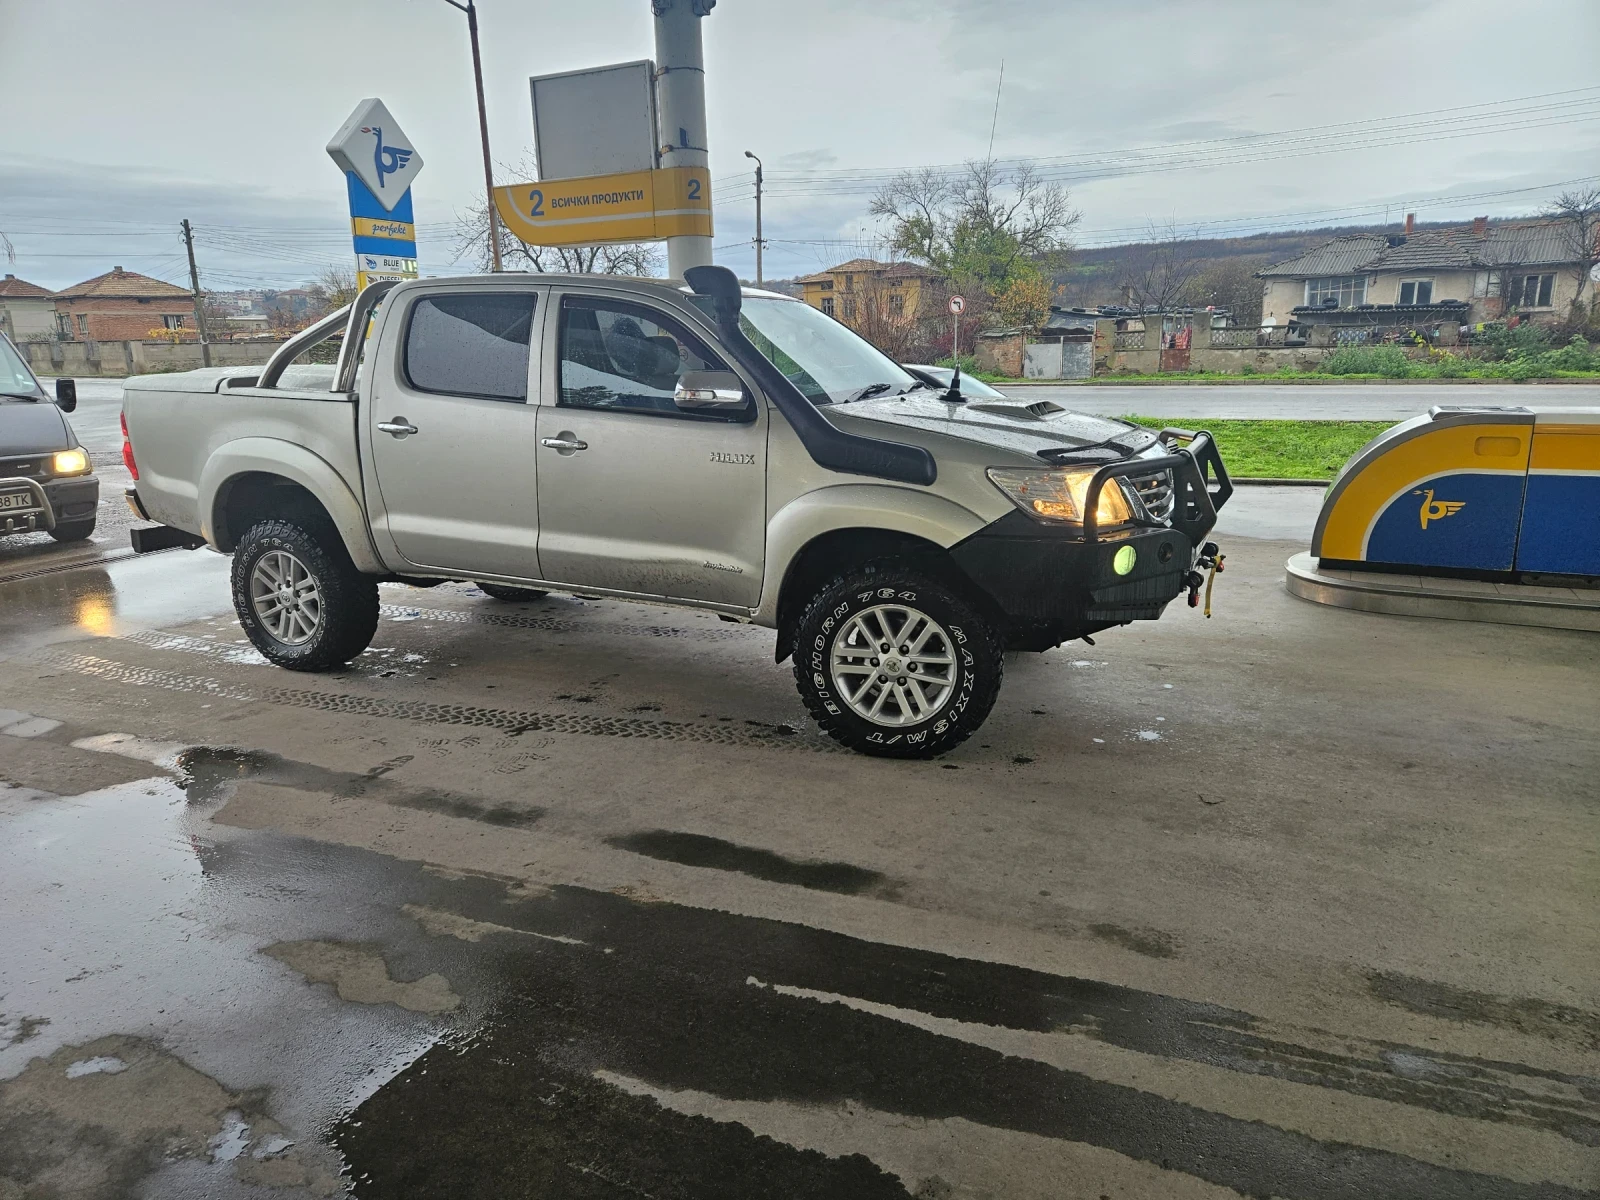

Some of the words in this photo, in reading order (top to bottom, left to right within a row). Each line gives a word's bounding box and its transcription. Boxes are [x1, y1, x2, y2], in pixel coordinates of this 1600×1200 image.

[687, 179, 701, 200] 2
[529, 189, 545, 217] 2
[551, 195, 590, 209] ВСИЧКИ
[591, 189, 644, 205] ПРОДУКТИ
[372, 223, 406, 236] perfekt
[383, 259, 400, 267] BLUE
[709, 452, 755, 465] HILUX
[13, 494, 29, 506] TK
[236, 544, 257, 627] BIGHORN
[811, 601, 850, 716] BIGHORN
[857, 587, 917, 602] 764
[933, 624, 975, 734] MAXXIS
[865, 730, 928, 745] M/T
